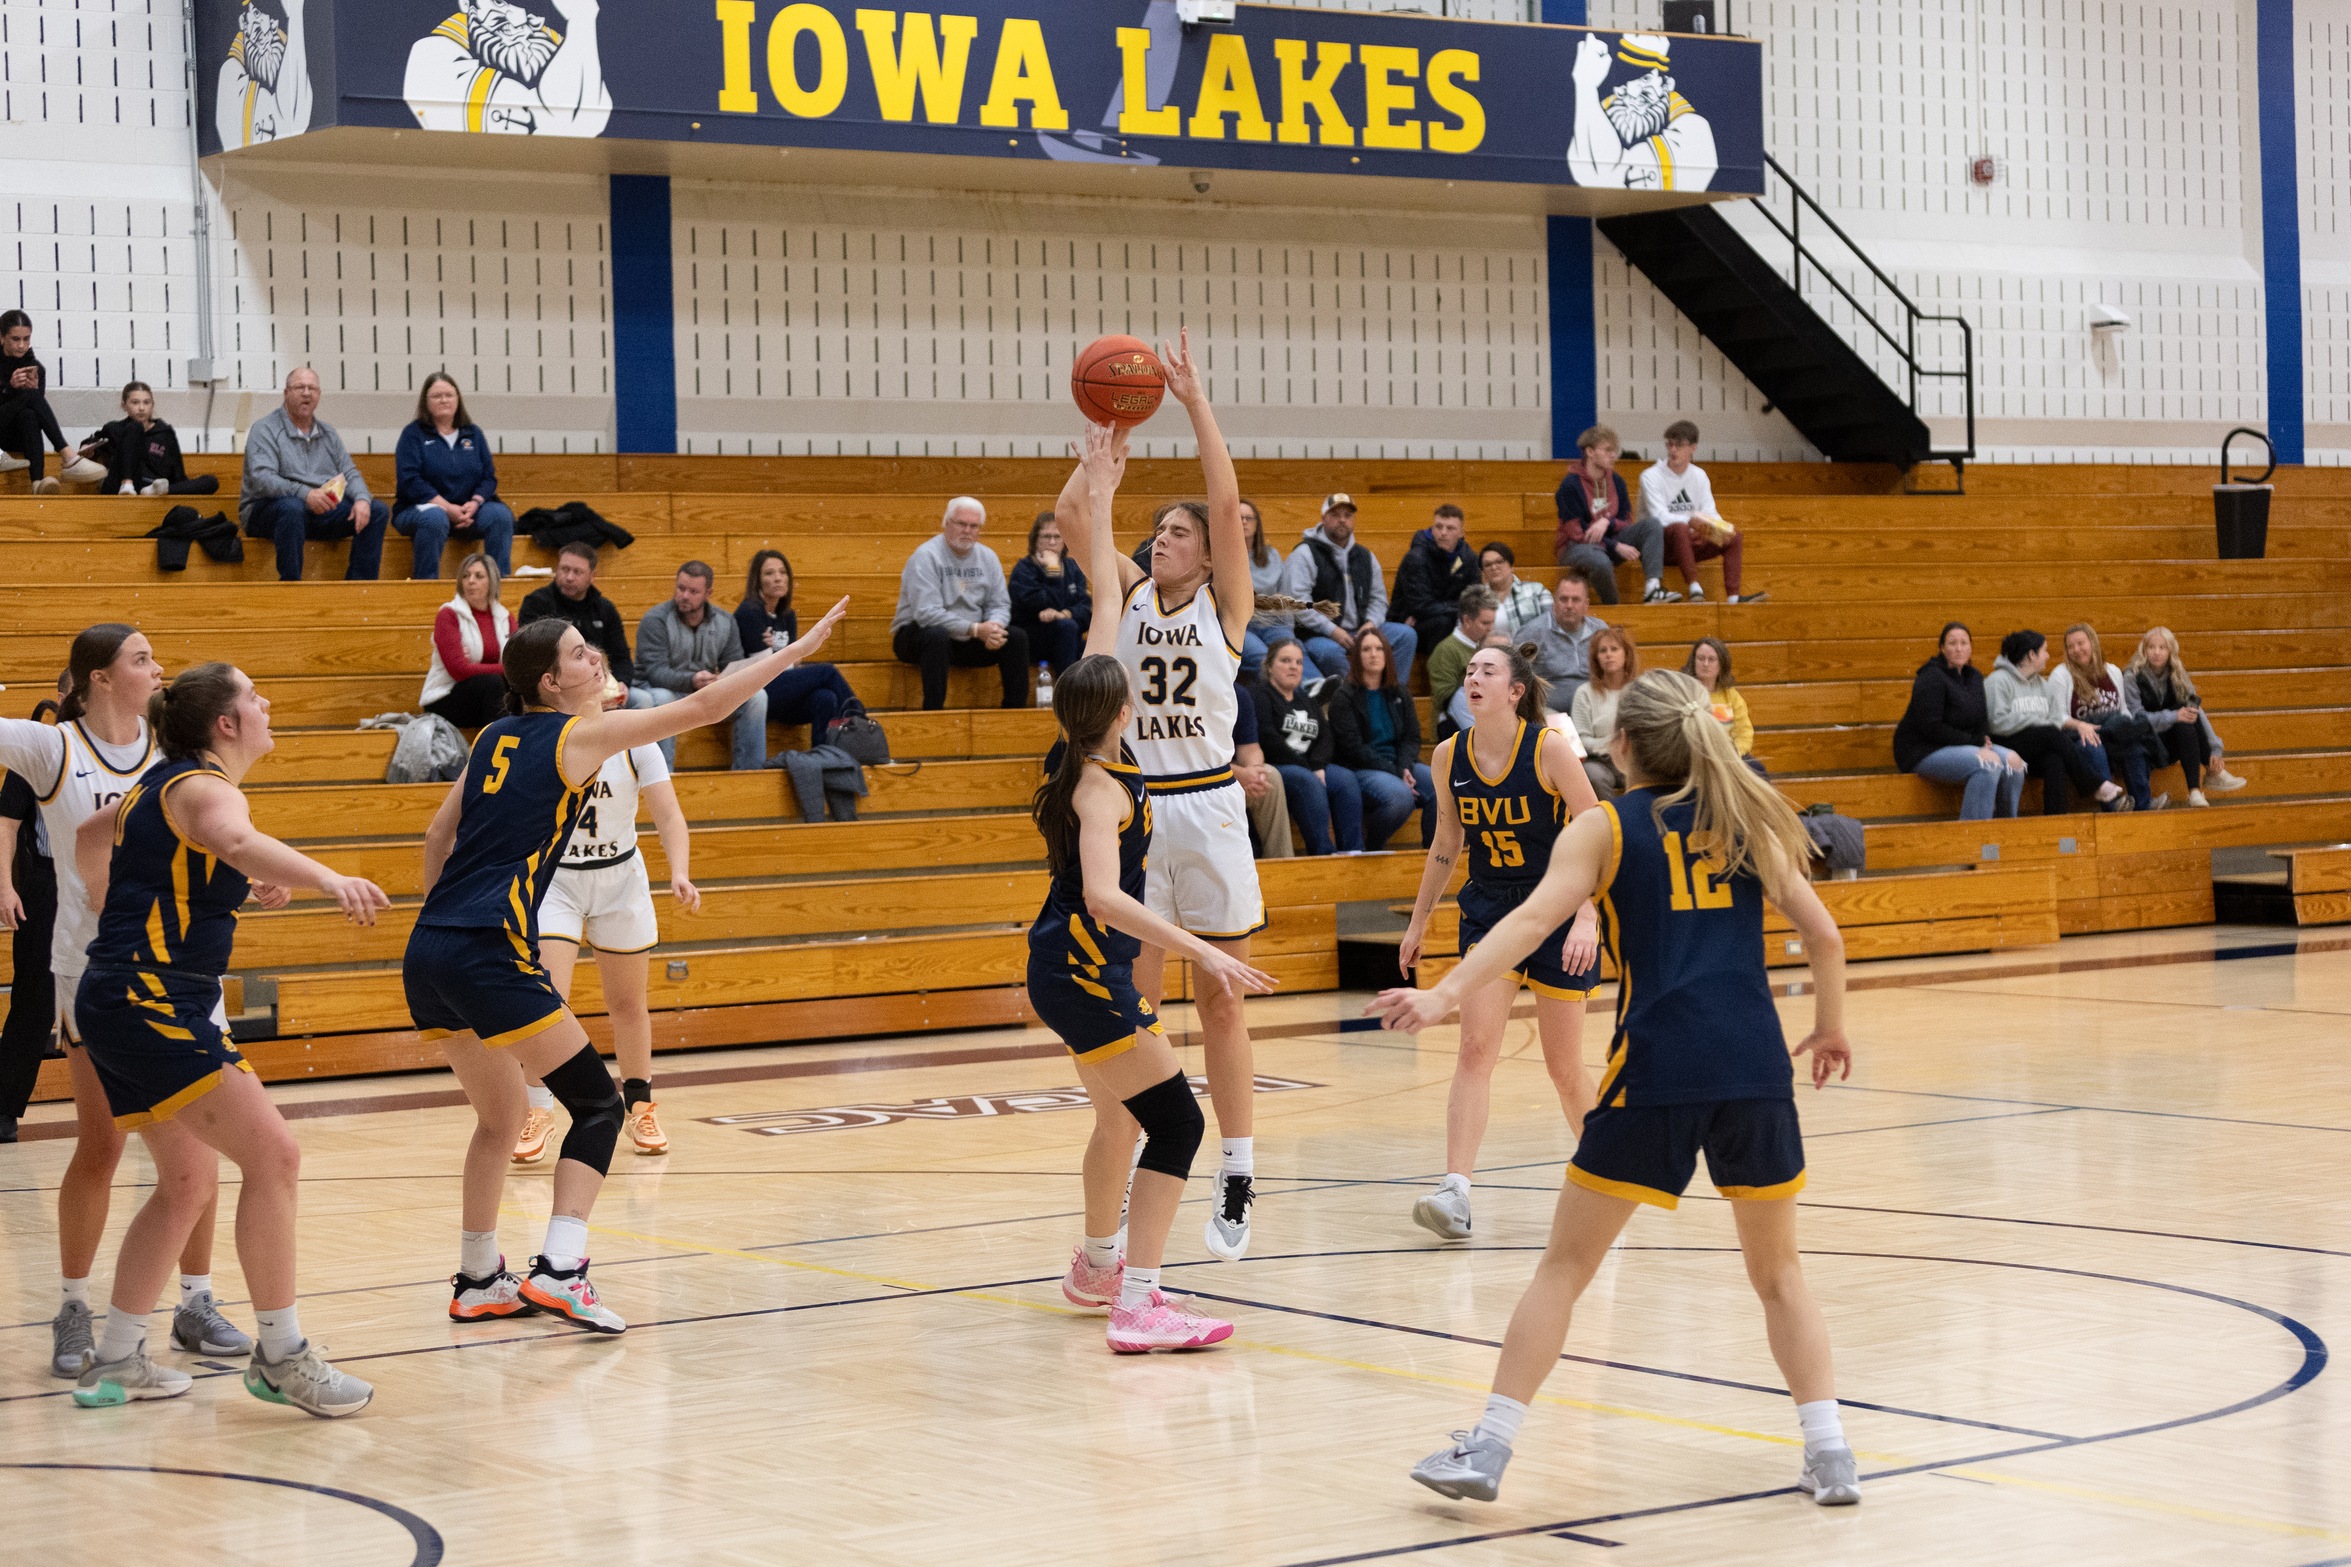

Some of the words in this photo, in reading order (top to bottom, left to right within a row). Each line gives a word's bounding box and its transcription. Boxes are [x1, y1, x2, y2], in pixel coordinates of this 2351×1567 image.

[716, 0, 1069, 131] IOWA
[1116, 27, 1487, 154] LAKES
[1137, 622, 1203, 646] IOWA
[1140, 655, 1199, 707] 32
[1137, 715, 1206, 741] LAKES
[483, 735, 521, 795] 5
[578, 805, 599, 838] 4
[1458, 795, 1531, 825] BVU
[563, 841, 618, 858] AKES
[1480, 830, 1526, 868] 15
[1662, 830, 1734, 911] 12
